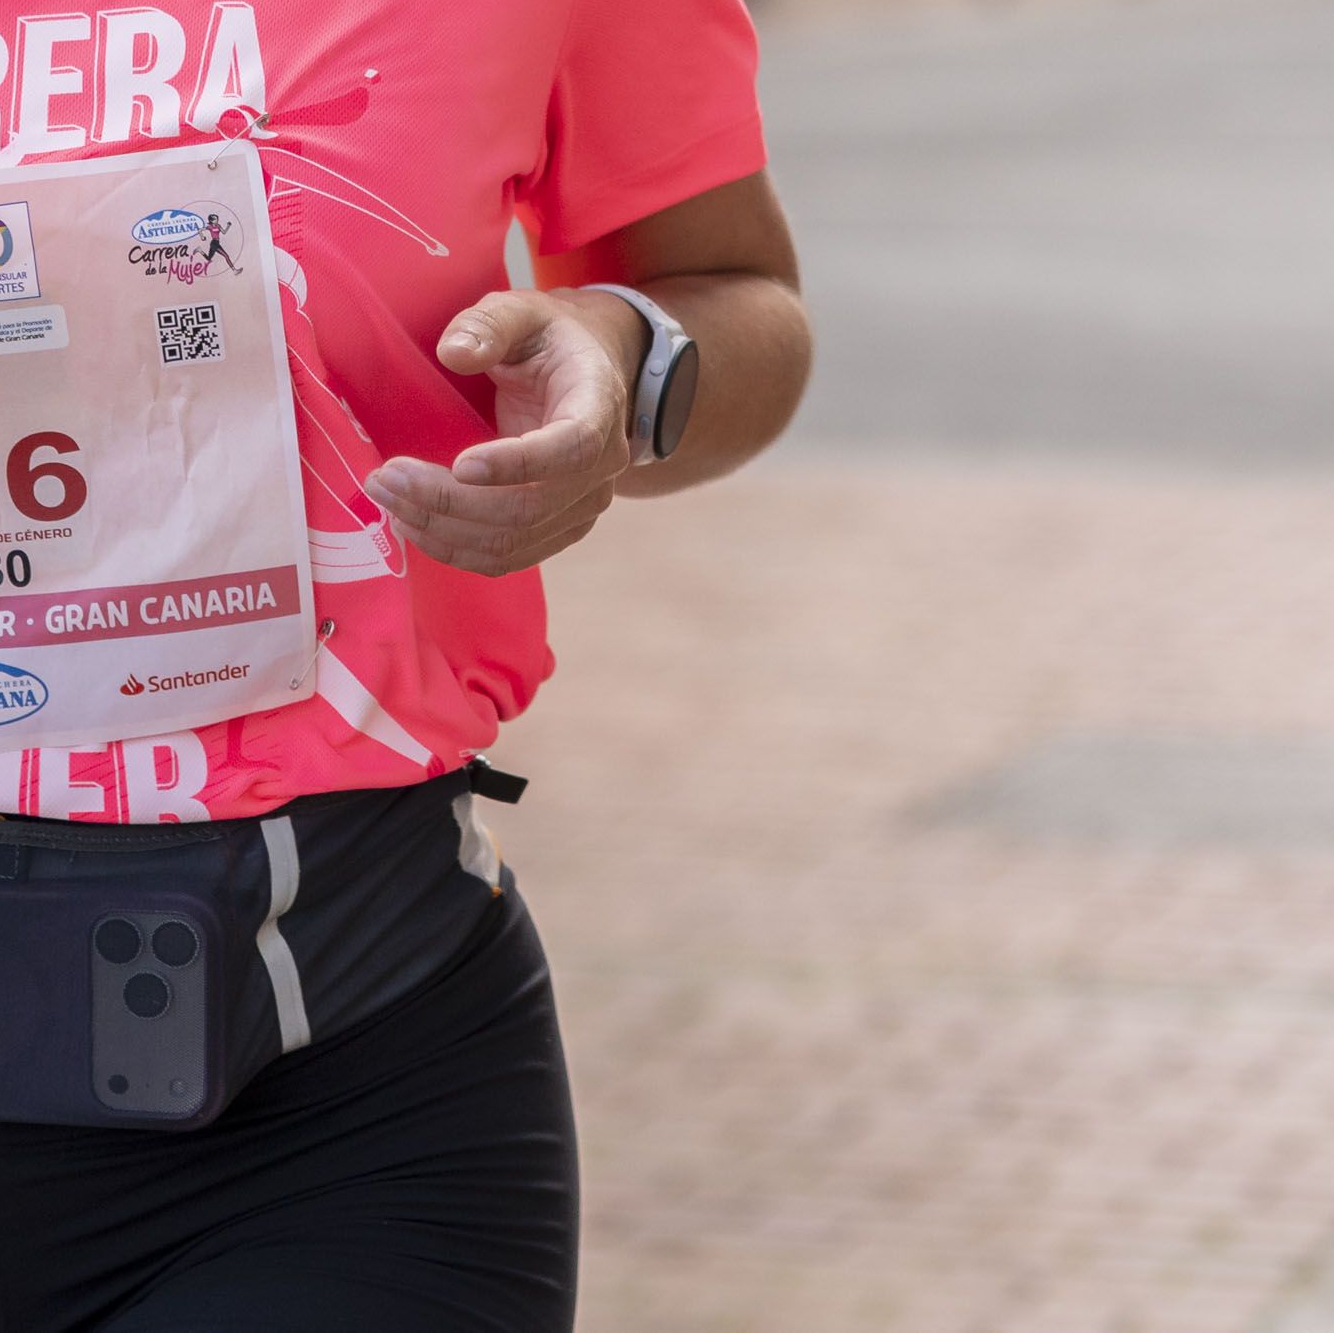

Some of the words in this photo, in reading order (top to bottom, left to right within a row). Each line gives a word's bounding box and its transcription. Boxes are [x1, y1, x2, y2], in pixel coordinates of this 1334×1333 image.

[138, 222, 200, 239] ASTURIANA
[128, 245, 189, 264] Carrera
[145, 263, 157, 276] de
[159, 261, 168, 275] la
[167, 256, 212, 285] Mujer
[15, 527, 73, 542] GÉNERO
[45, 600, 130, 635] GRAN
[139, 582, 277, 625] CANARIA
[148, 664, 250, 694] Santander
